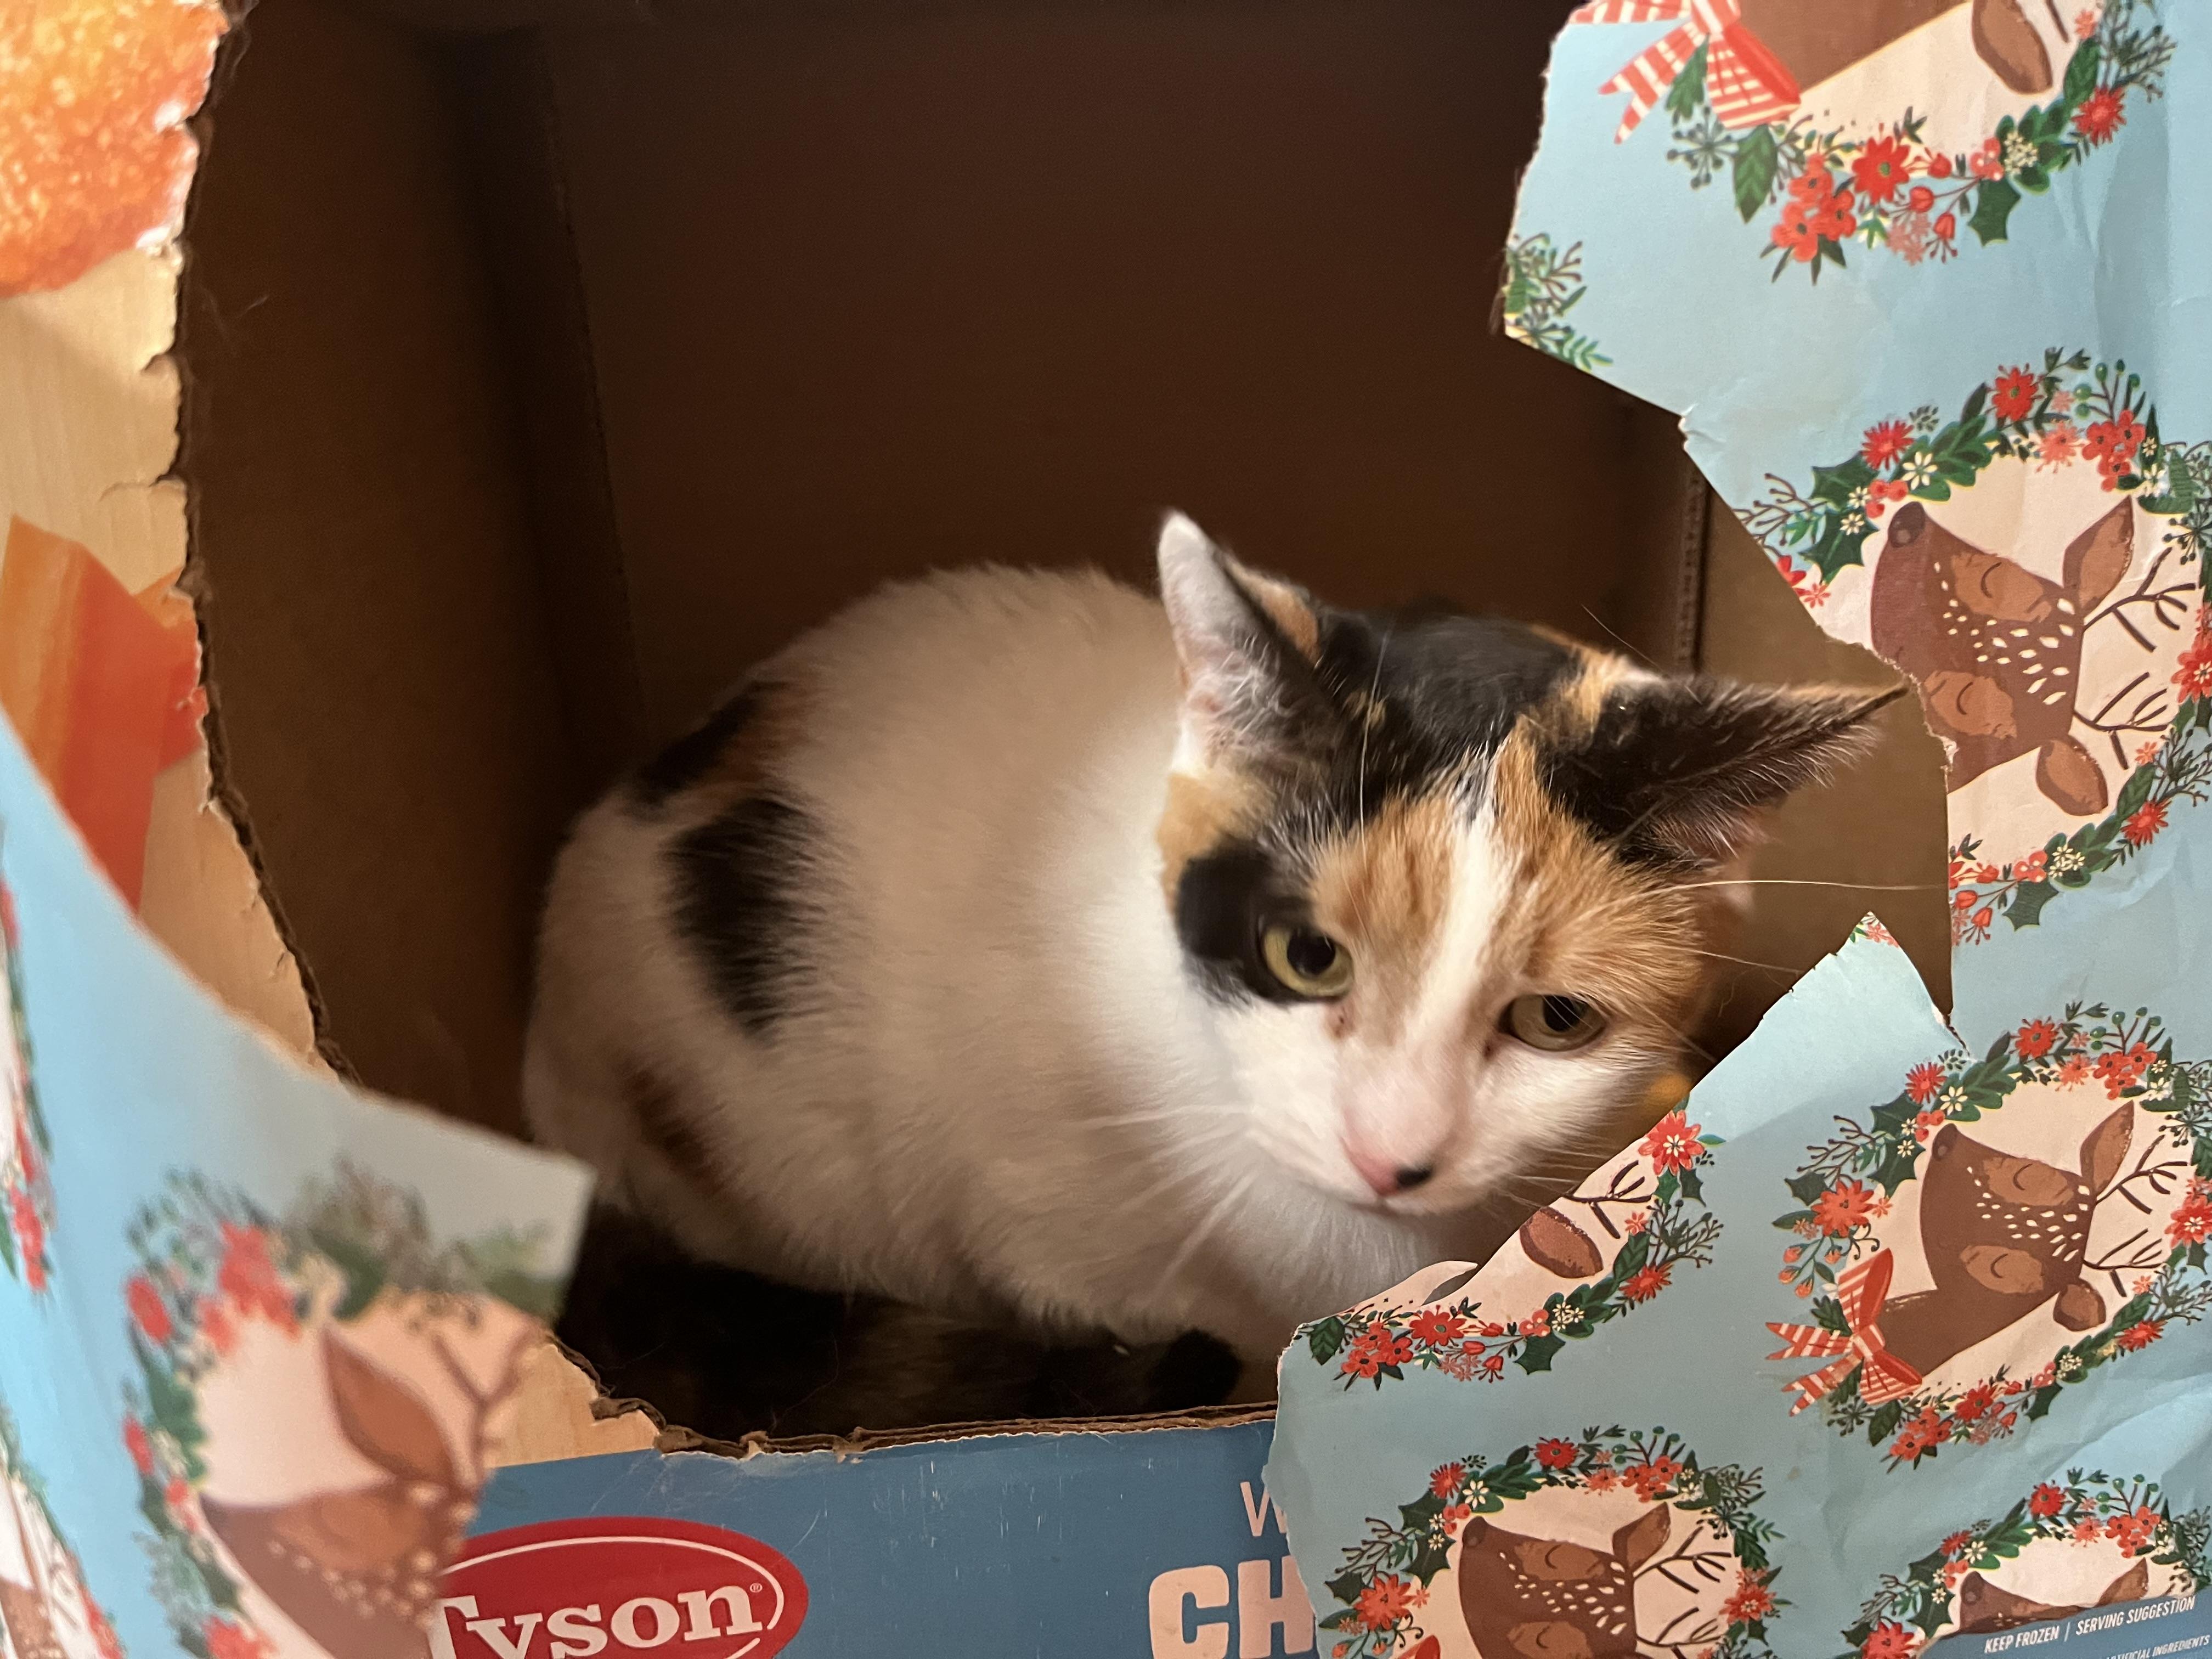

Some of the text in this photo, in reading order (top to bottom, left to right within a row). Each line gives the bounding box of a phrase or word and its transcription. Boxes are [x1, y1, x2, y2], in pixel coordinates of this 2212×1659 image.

[1984, 1595, 2196, 1655] KEEP FROZEN SERVING SUGGESTION
[2107, 1634, 2210, 1659] TIFICIAL INGREDIENTS
